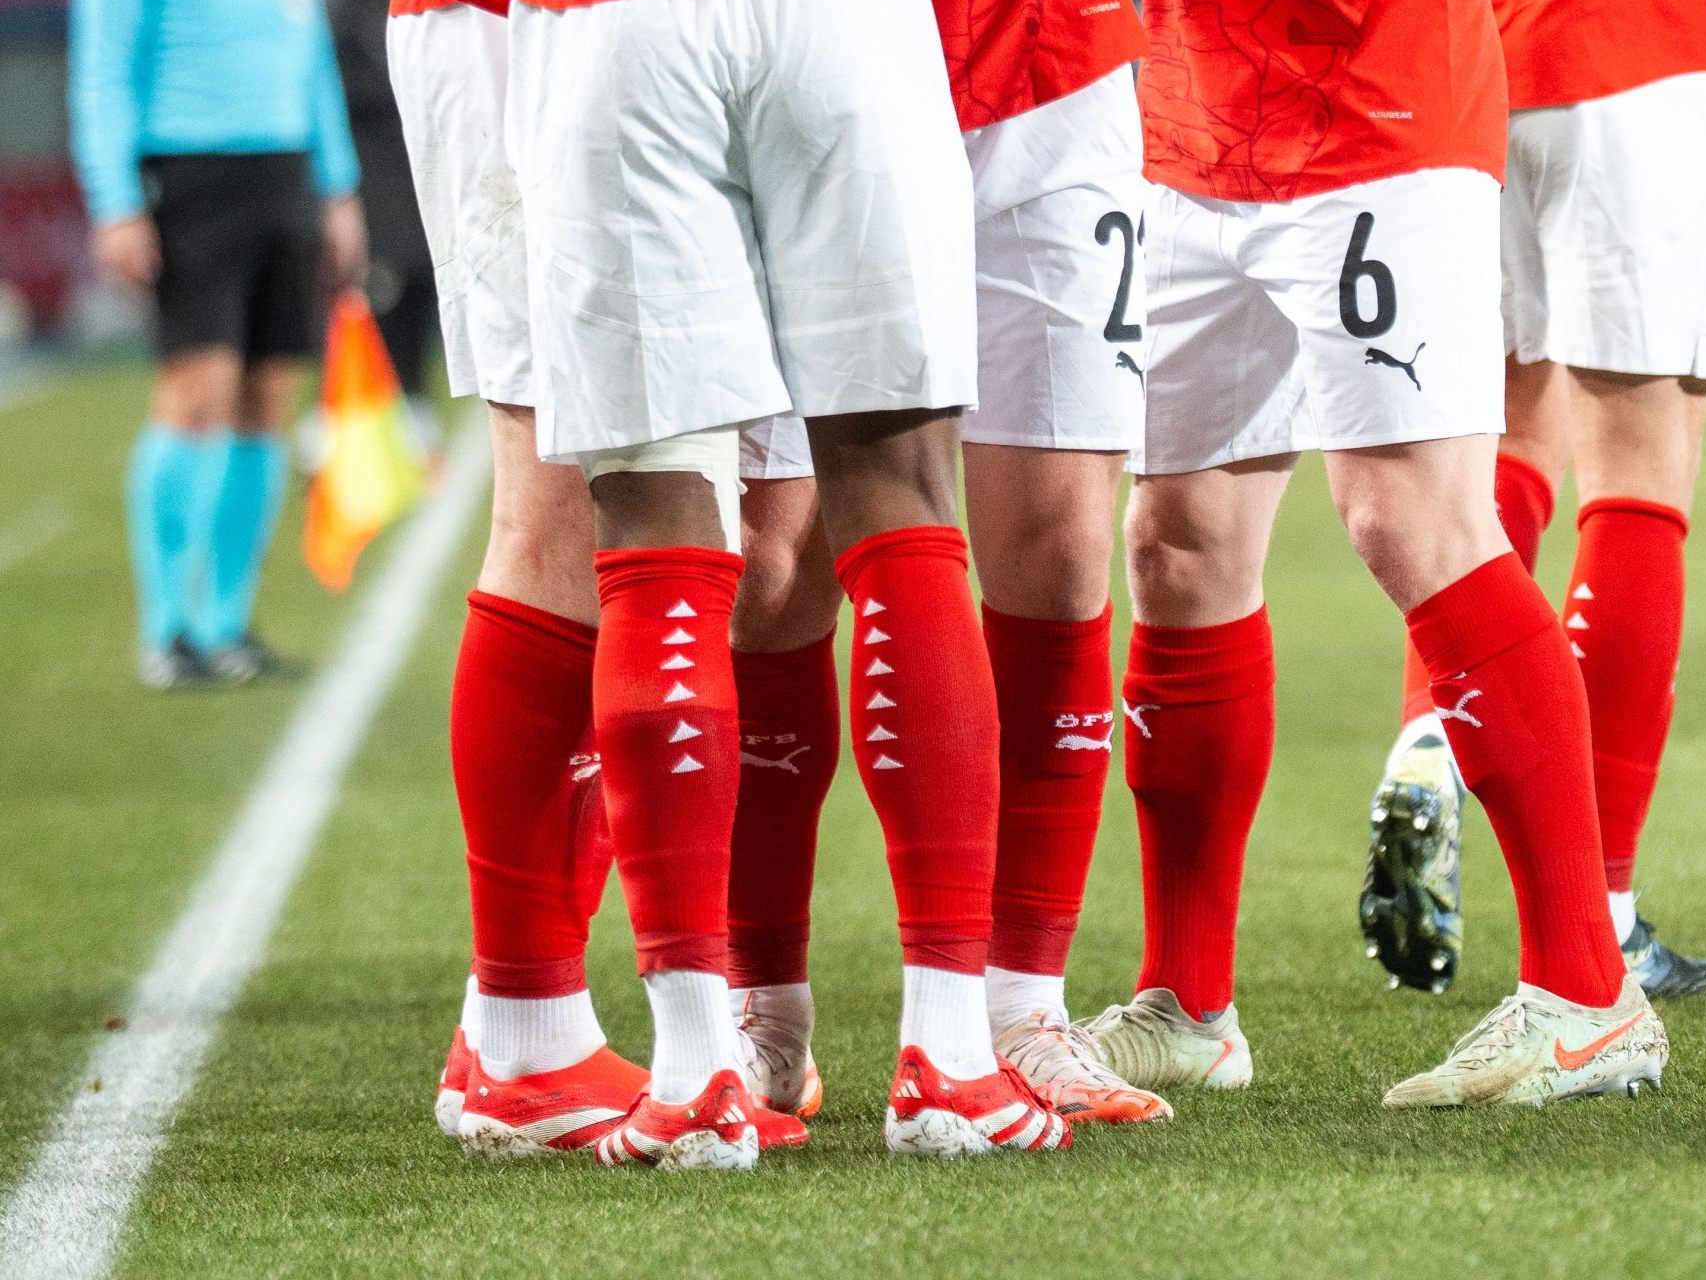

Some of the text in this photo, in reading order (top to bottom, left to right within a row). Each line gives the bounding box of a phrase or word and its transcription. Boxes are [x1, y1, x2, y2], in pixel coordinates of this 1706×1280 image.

[1368, 111, 1414, 120] ULTRAWEAVE
[1339, 211, 1397, 340] 6
[739, 733, 797, 745] FB
